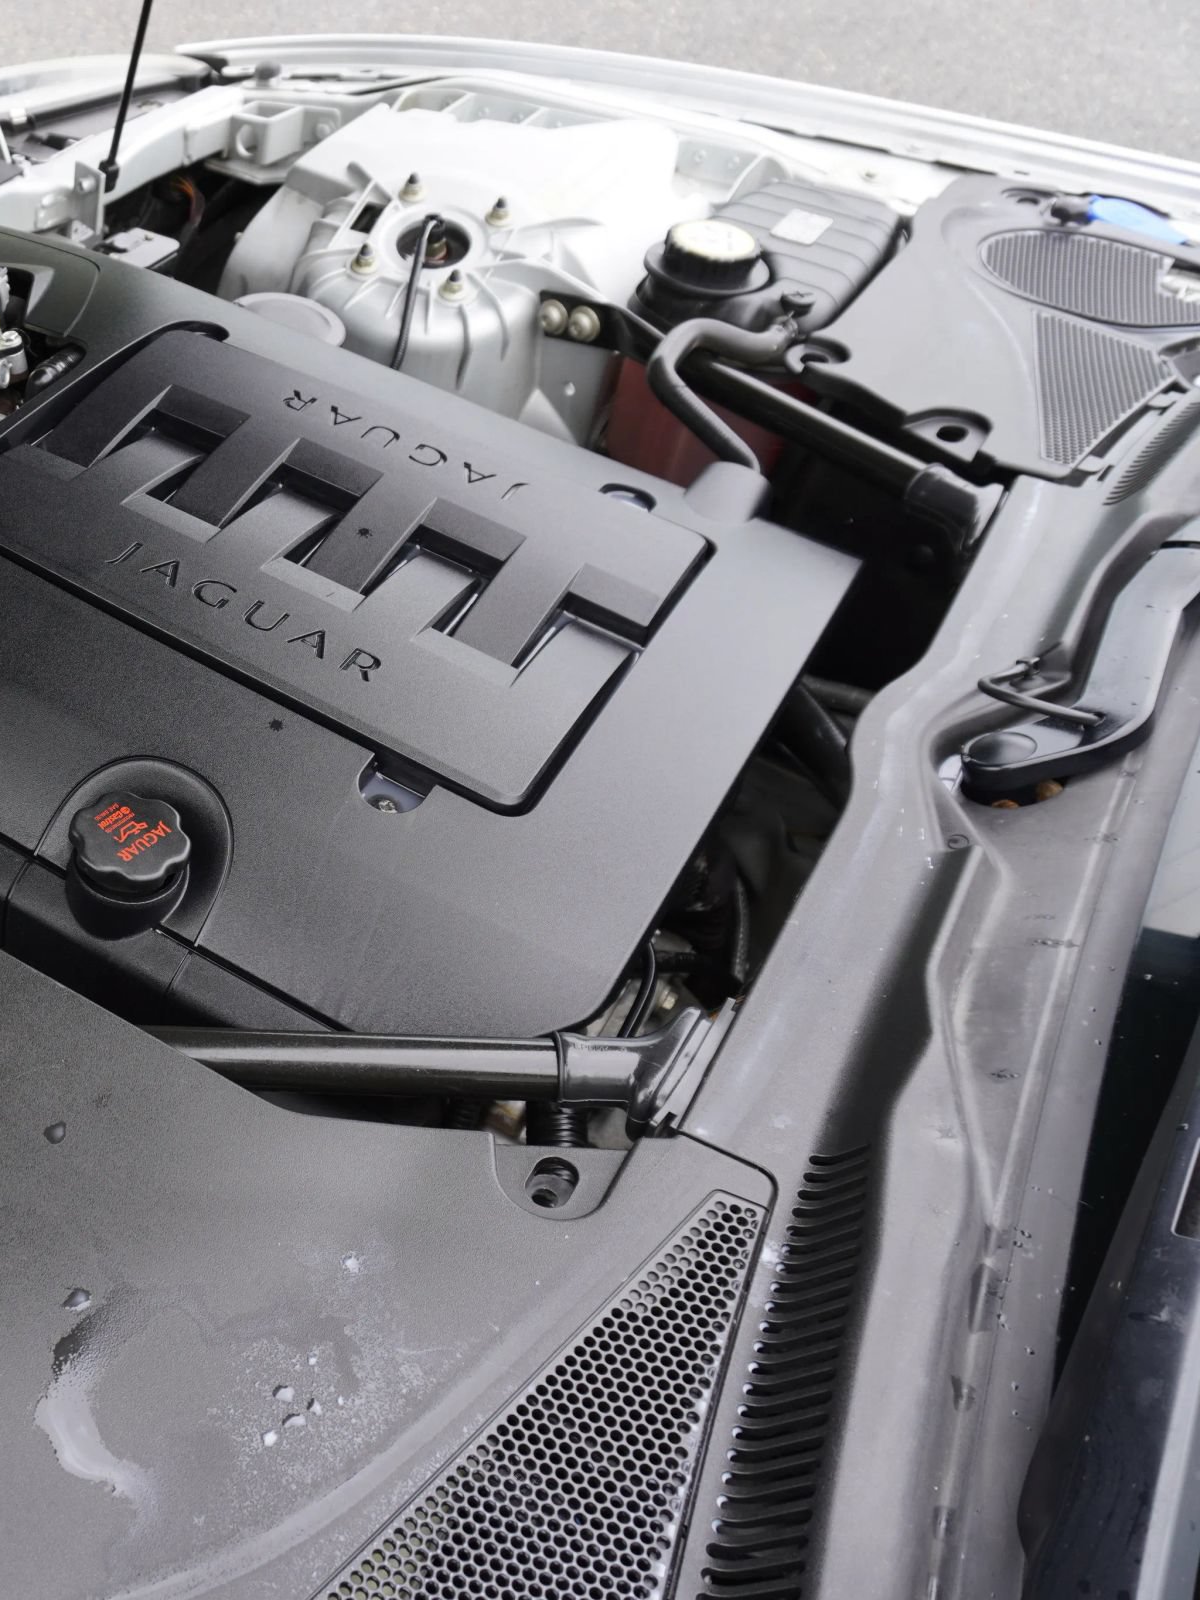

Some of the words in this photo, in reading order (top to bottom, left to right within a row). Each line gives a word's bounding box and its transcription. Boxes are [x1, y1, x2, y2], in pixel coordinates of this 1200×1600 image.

[282, 387, 532, 502] JAGUAR
[104, 540, 385, 683] JAGUAR
[97, 811, 123, 829] Castrol
[115, 820, 172, 861] JAGUAR
